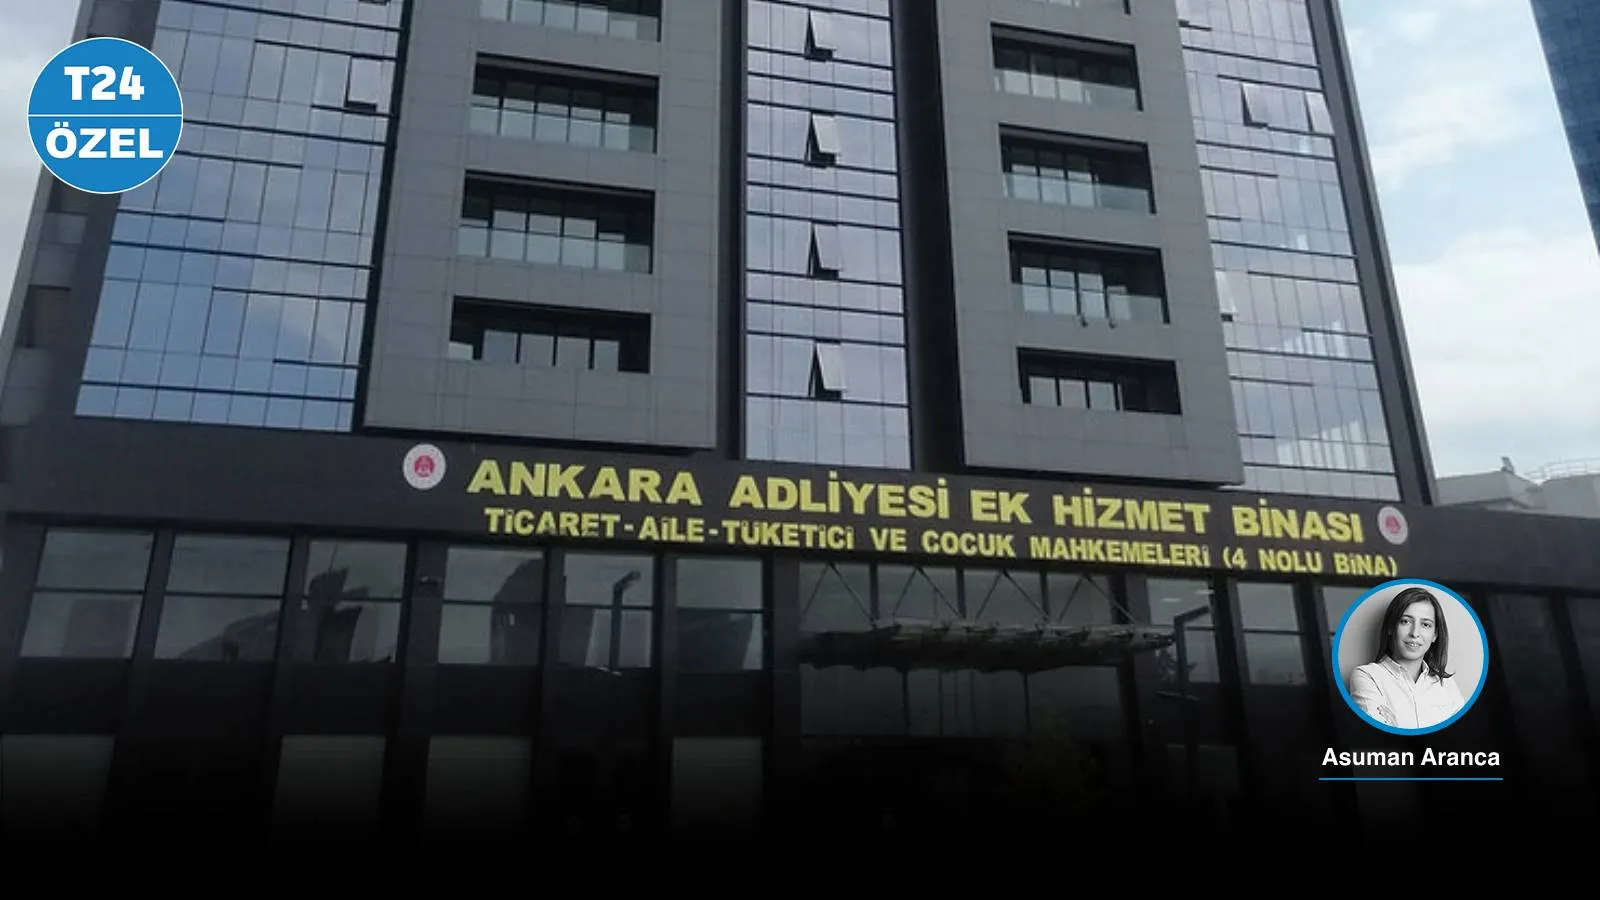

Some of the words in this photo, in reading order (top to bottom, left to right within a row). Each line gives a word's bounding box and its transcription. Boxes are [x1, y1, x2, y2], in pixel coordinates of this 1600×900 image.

[466, 459, 702, 506] ANKARA
[729, 470, 950, 521] ADLİYESİ
[969, 488, 1032, 526] EK
[1052, 486, 1211, 536] HİZMET
[1232, 497, 1365, 545] BİNASI
[868, 526, 907, 553] VE
[1029, 534, 1211, 568] MAHKEMELERİ
[1222, 546, 1248, 570] (4
[1257, 547, 1323, 575] NOLU
